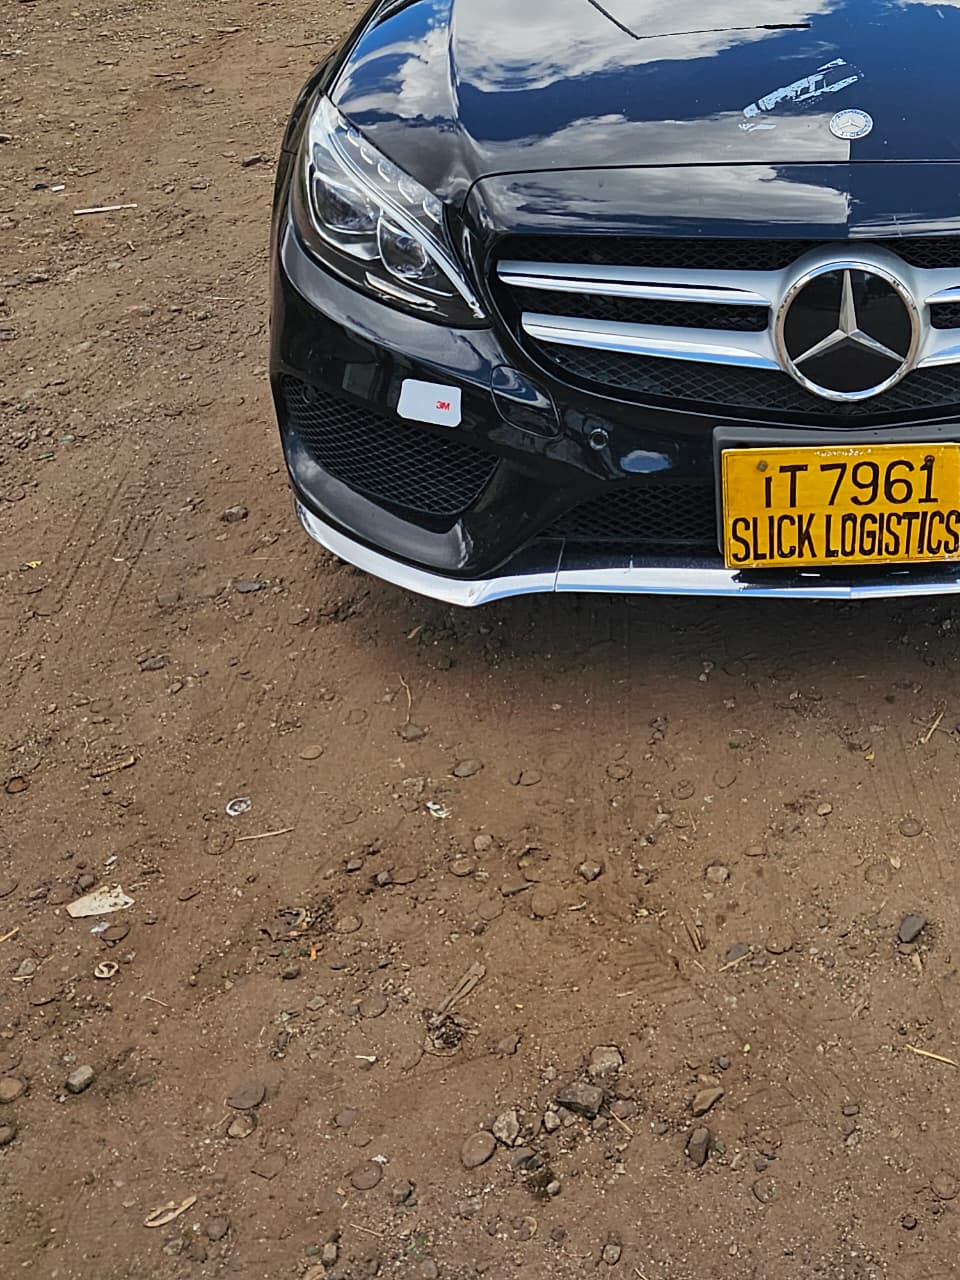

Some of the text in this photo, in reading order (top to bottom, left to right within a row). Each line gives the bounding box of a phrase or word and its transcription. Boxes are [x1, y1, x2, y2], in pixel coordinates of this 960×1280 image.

[436, 401, 450, 411] 3M
[820, 455, 938, 506] 7961
[731, 510, 960, 563] SLICK LOGISTICS
